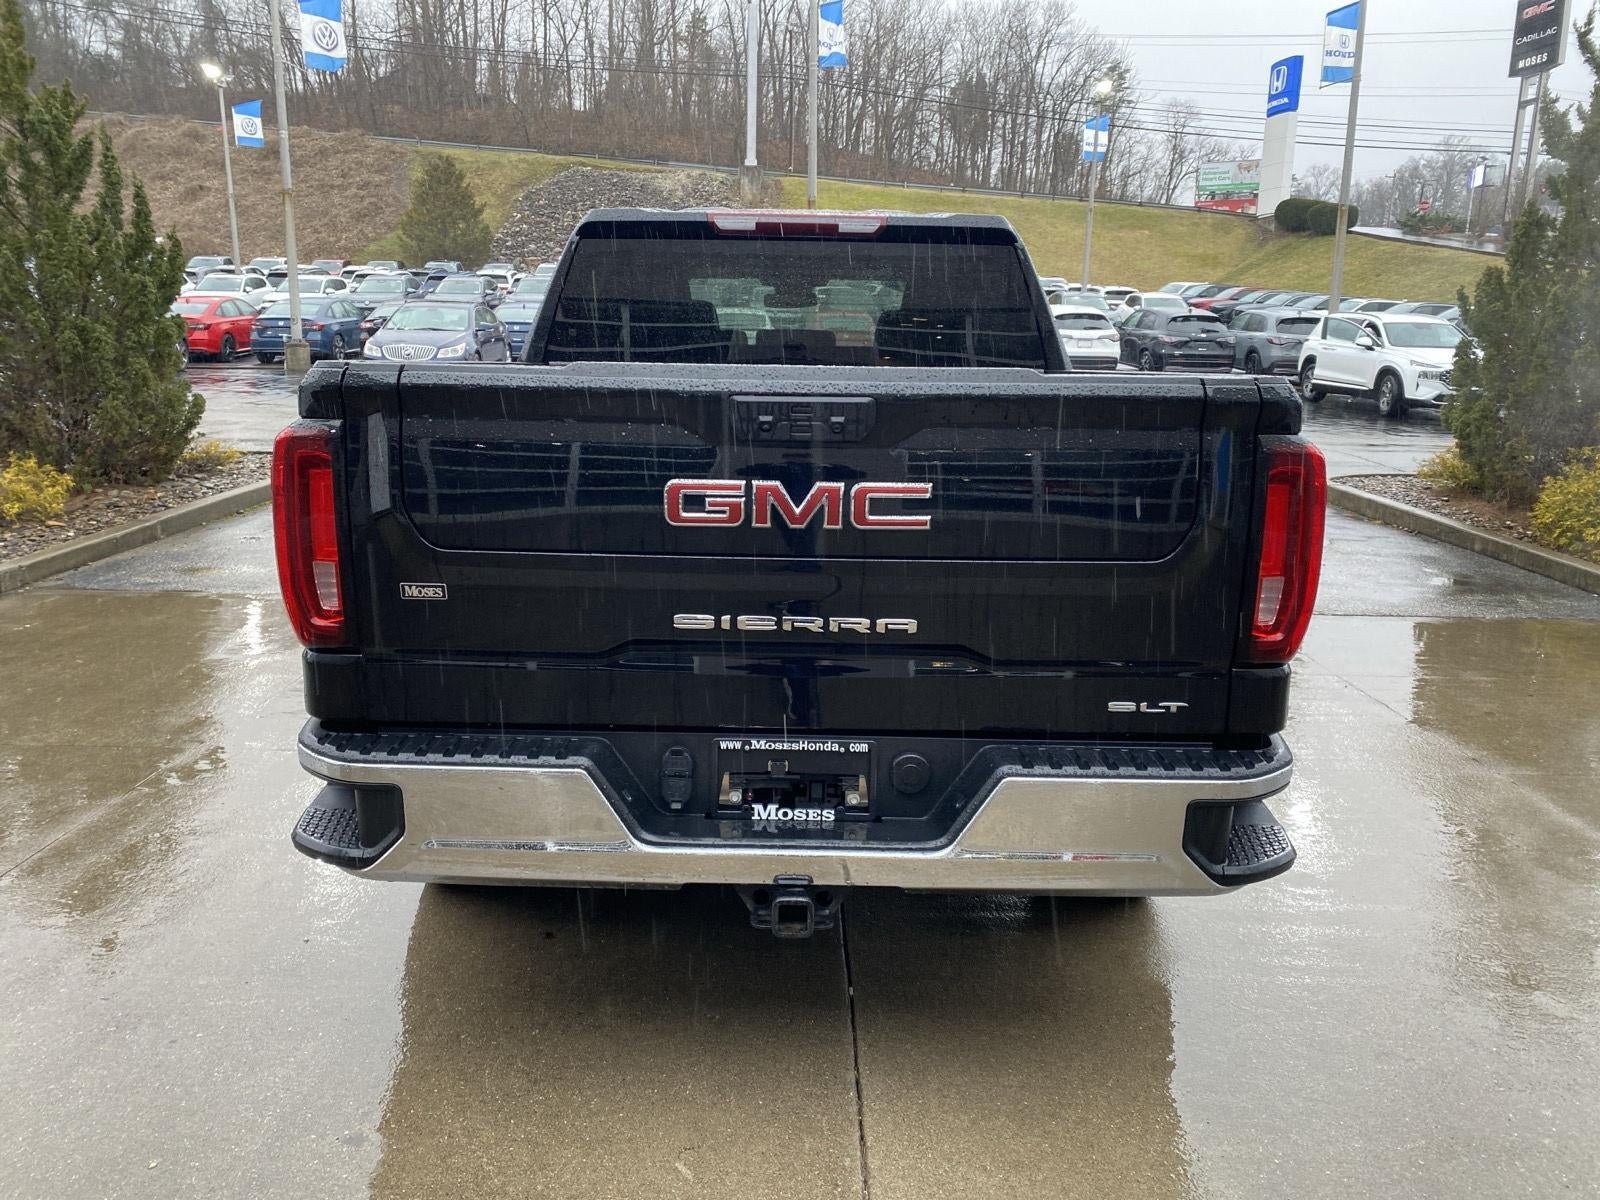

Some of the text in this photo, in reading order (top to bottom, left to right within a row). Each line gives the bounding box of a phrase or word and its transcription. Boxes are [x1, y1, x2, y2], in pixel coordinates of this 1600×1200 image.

[1515, 26, 1558, 46] CADILLAC
[1325, 49, 1356, 59] HOND
[1518, 52, 1549, 69] MOSES
[664, 478, 933, 530] GMC
[403, 585, 443, 598] MOSES
[673, 613, 919, 634] SIERRA
[1107, 701, 1189, 713] SLT
[751, 803, 836, 822] MOSES
